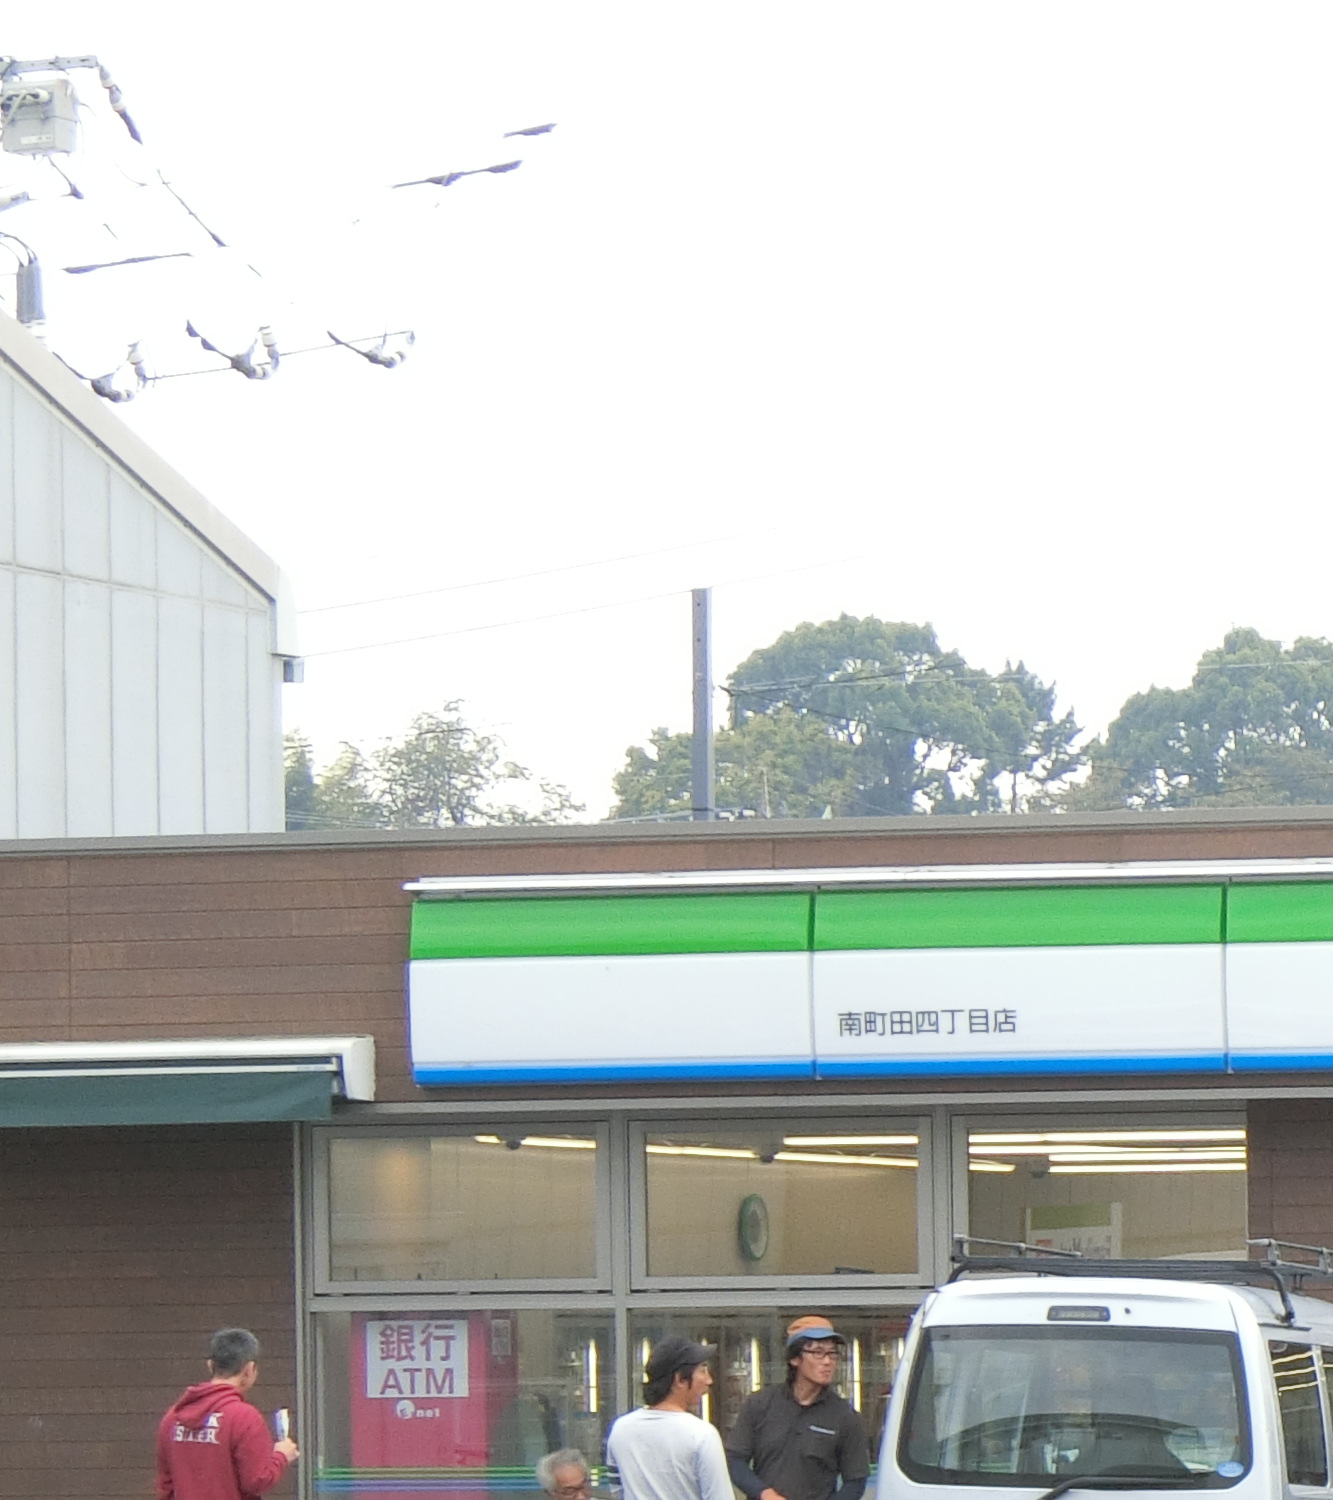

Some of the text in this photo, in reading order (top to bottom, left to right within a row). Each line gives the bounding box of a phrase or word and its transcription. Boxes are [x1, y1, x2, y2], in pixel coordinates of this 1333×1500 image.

[837, 1007, 1017, 1037] 南町田四丁目店
[379, 1323, 457, 1362] 銀行
[380, 1368, 454, 1395] ATM
